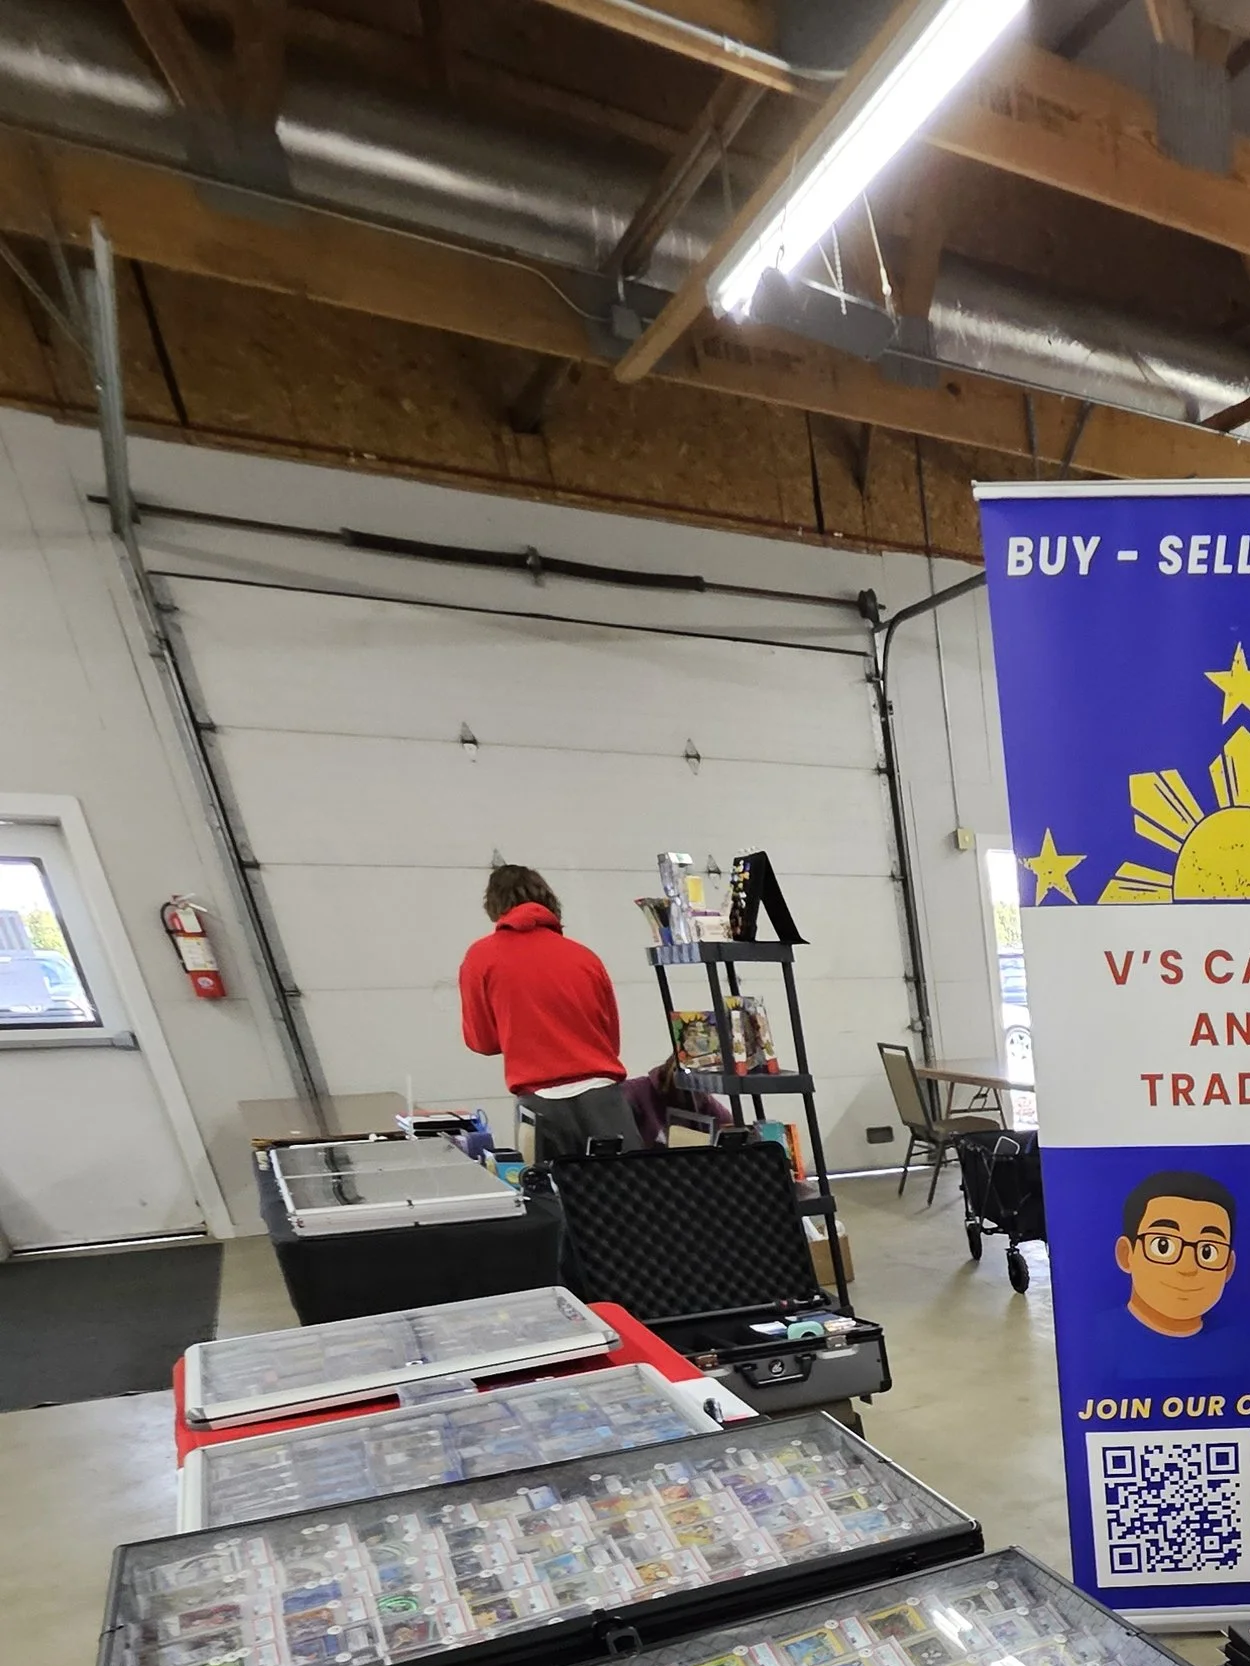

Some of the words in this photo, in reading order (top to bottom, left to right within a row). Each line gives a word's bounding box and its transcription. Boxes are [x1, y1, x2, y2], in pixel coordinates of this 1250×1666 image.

[1006, 534, 1101, 577] BUY
[1105, 950, 1183, 986] V'S
[1078, 1398, 1152, 1421] JOIN
[1161, 1396, 1225, 1418] OUR
